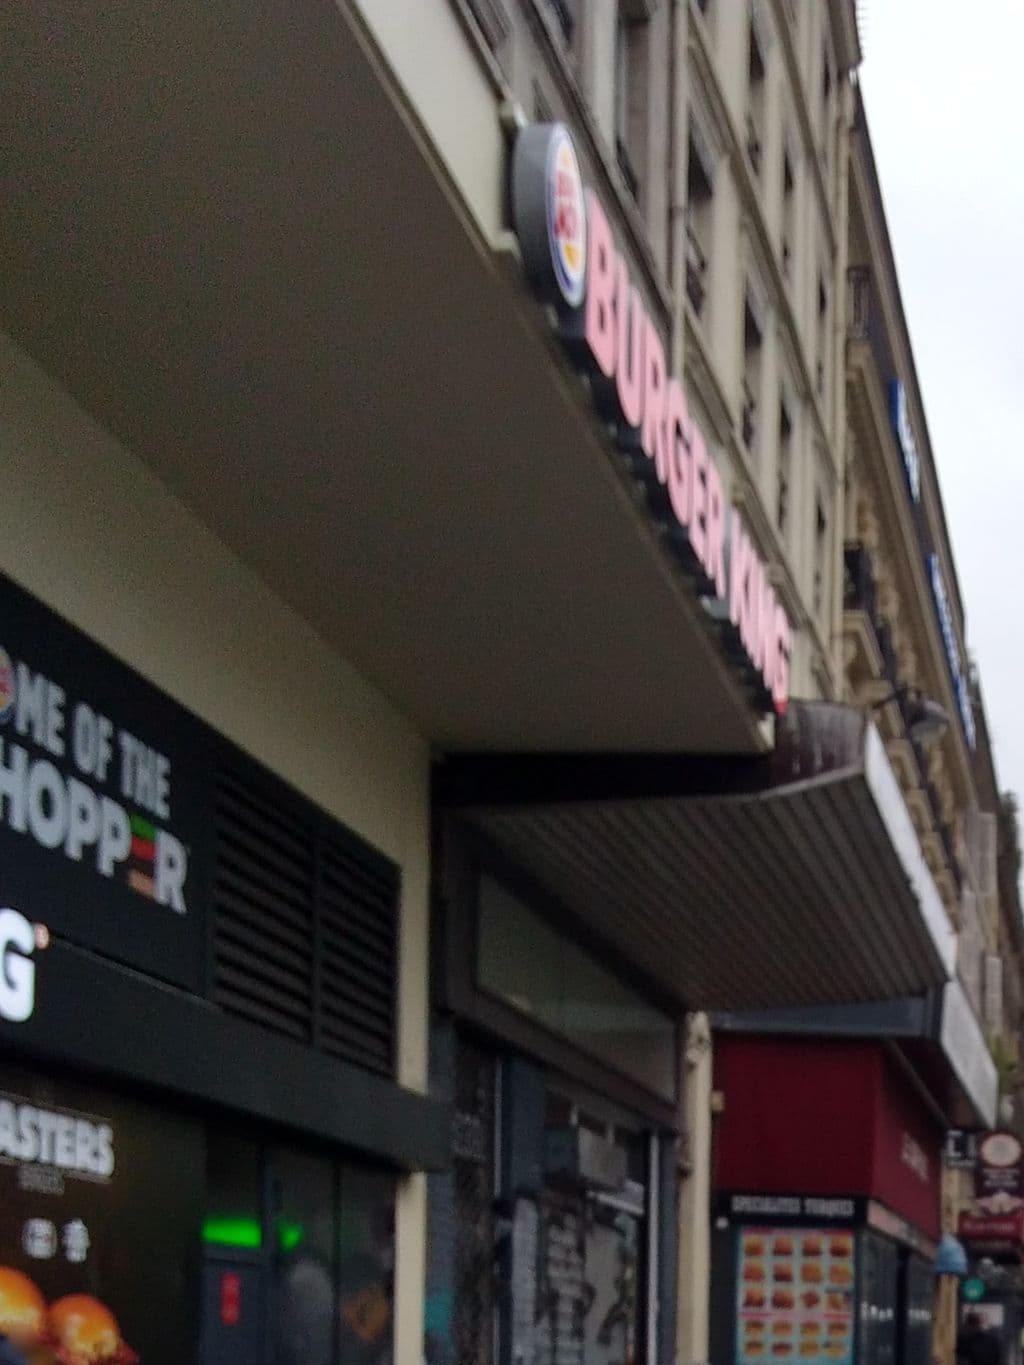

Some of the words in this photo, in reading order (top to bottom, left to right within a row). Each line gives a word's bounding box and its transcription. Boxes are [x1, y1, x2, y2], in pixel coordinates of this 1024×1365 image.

[584, 188, 726, 599] BURGER
[729, 505, 791, 715] KING
[72, 702, 114, 782] OF
[118, 729, 171, 820] THE
